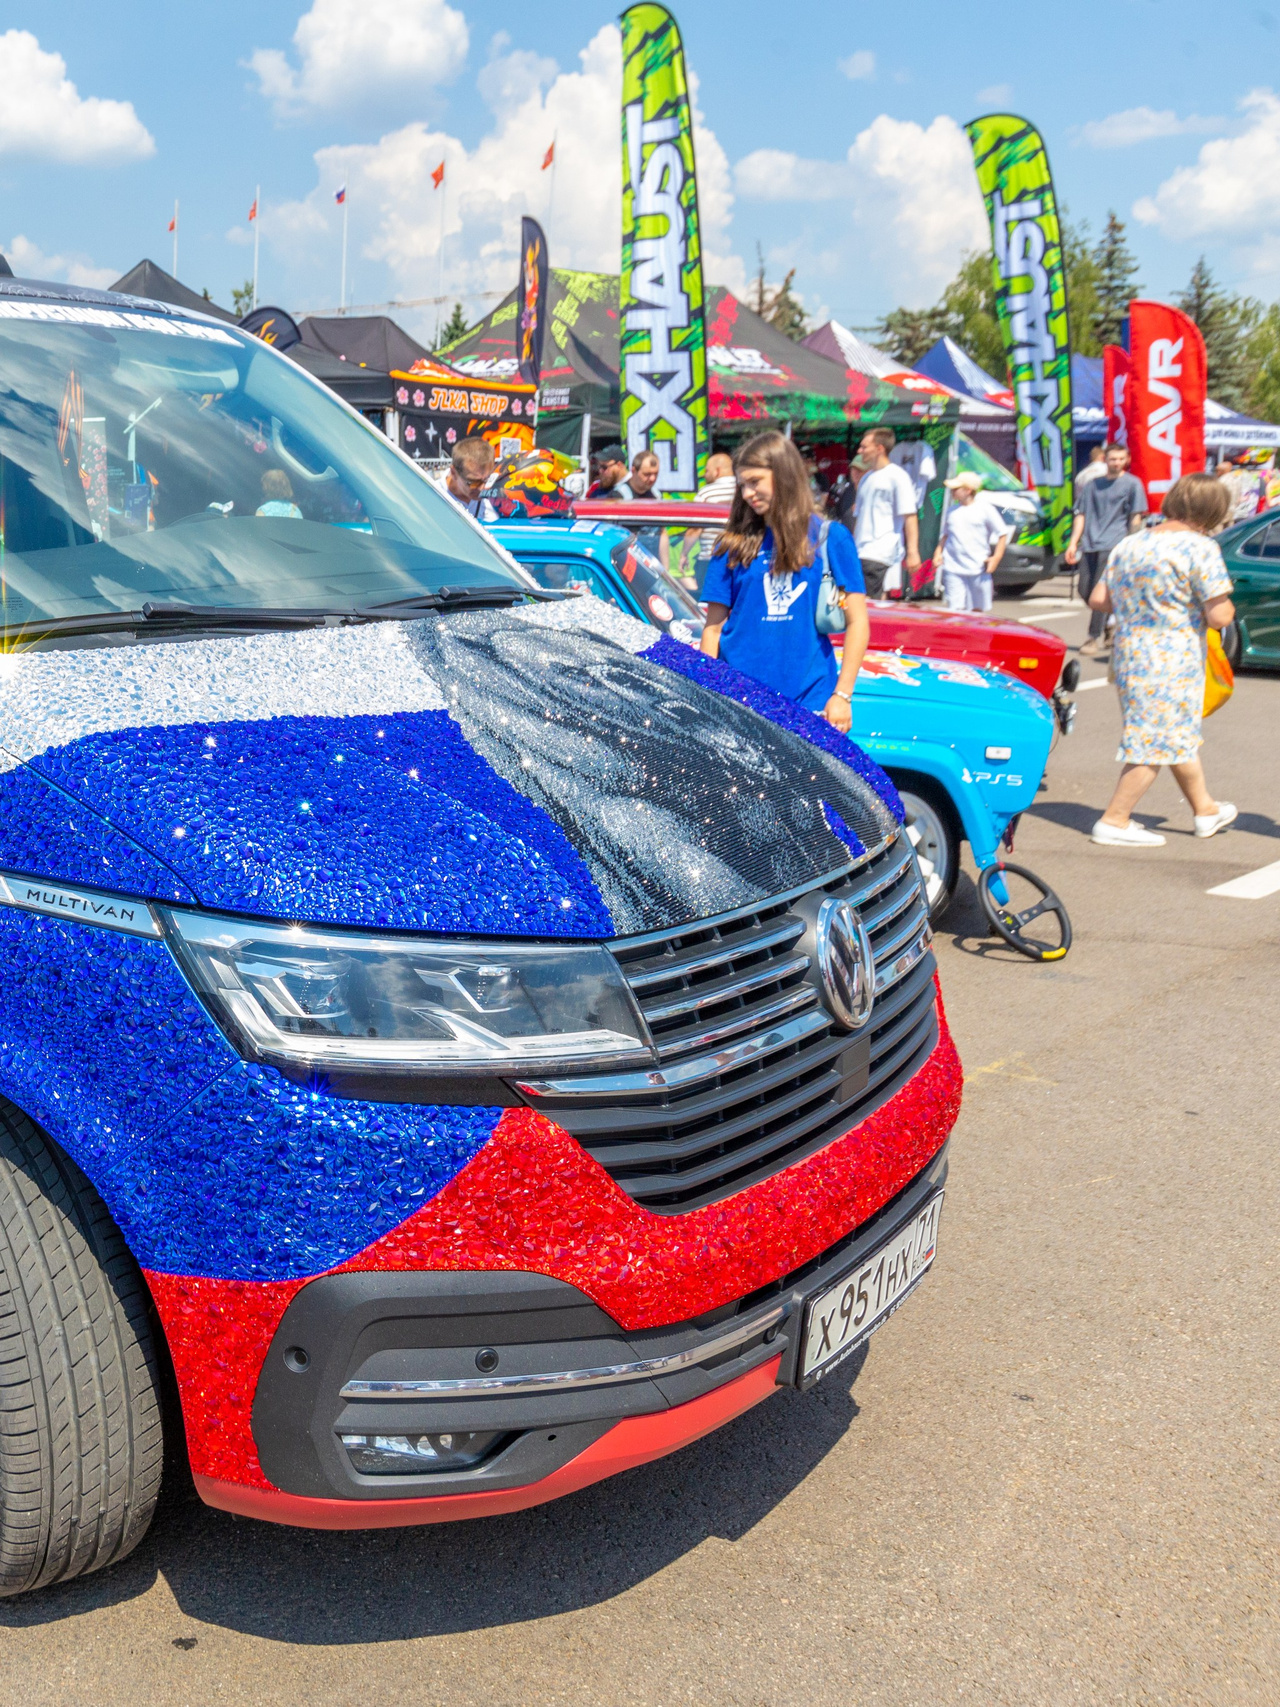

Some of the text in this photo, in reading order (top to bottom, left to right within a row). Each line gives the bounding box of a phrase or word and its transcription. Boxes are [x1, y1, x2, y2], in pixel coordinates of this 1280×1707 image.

[625, 103, 696, 493] EXHAUST
[991, 190, 1063, 487] EXHAUST
[470, 391, 509, 417] SHOP
[1147, 336, 1185, 494] LAVR
[975, 771, 1023, 787] PS5
[26, 888, 135, 922] MULTIVAN
